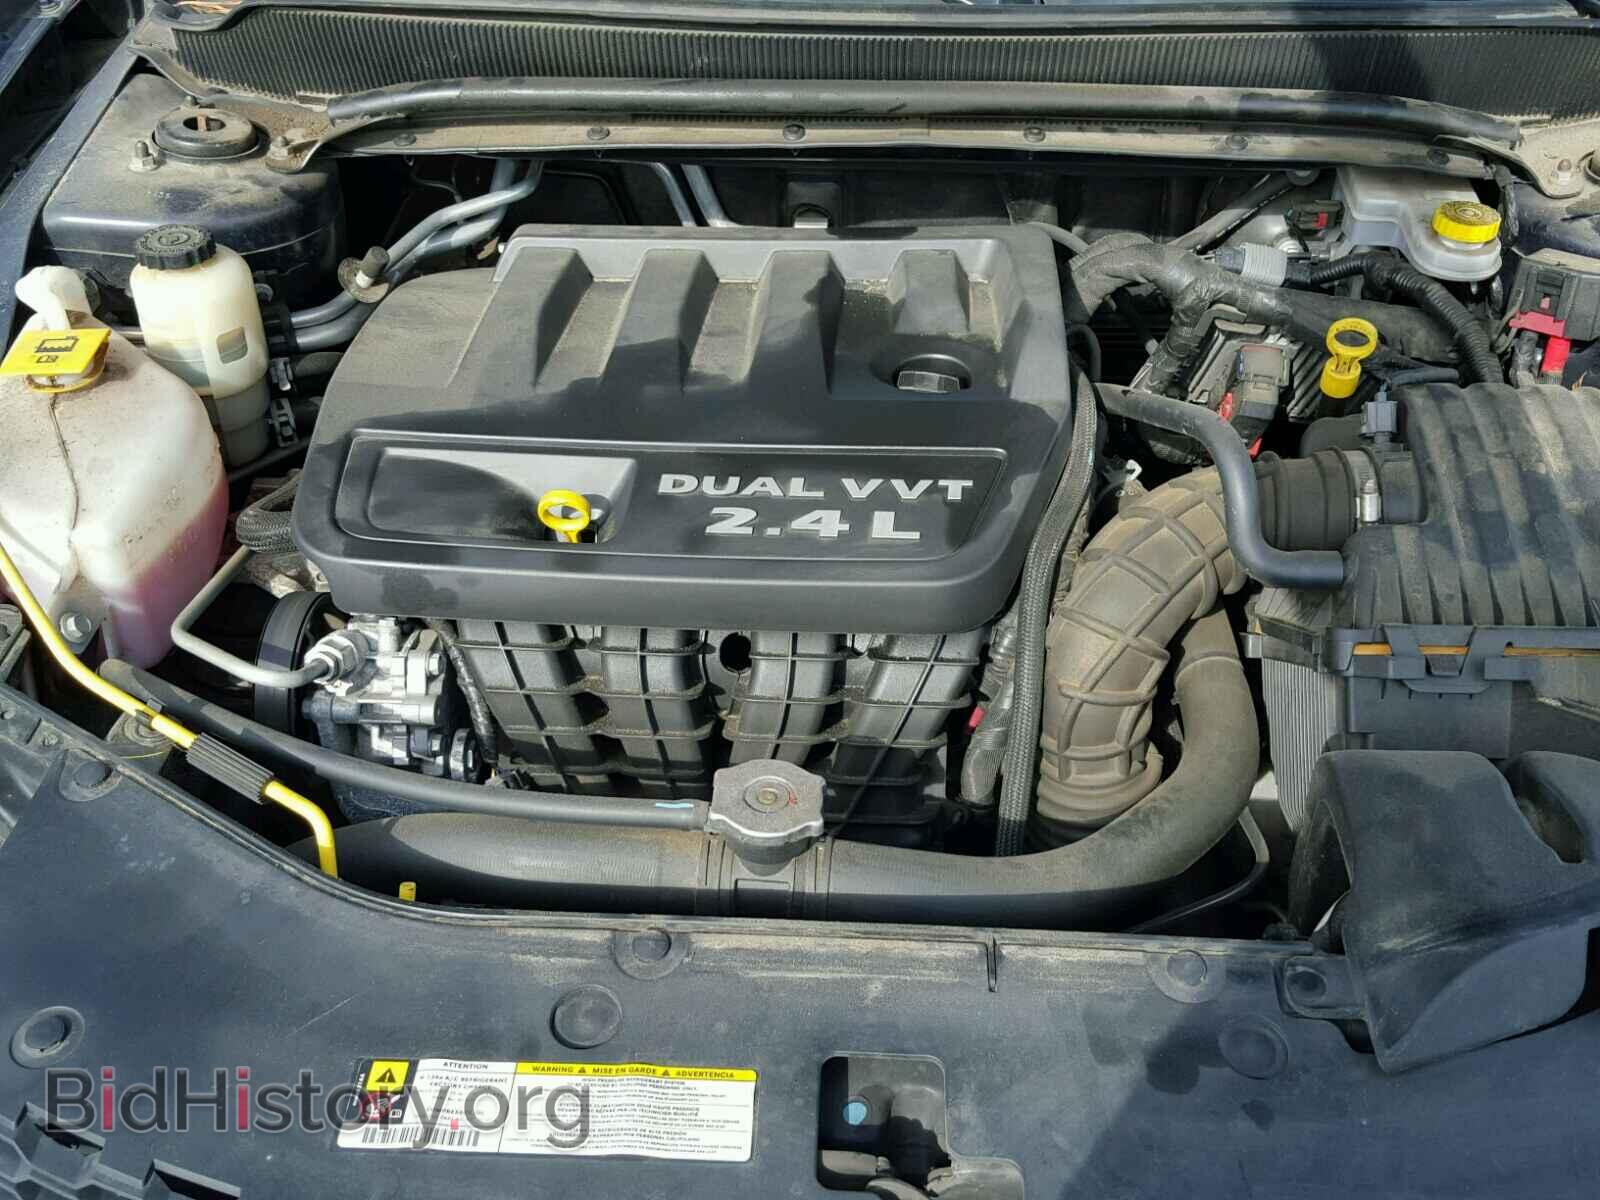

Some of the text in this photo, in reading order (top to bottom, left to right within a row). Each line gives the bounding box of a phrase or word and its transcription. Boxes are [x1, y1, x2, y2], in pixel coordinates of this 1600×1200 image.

[657, 473, 974, 500] DUAL VVT
[443, 1062, 489, 1070] ATTENTION
[532, 1064, 574, 1073] WARNING
[592, 1066, 613, 1074] MISE
[628, 1065, 657, 1075] GARDE
[676, 1069, 735, 1079] ADVERTENCIA
